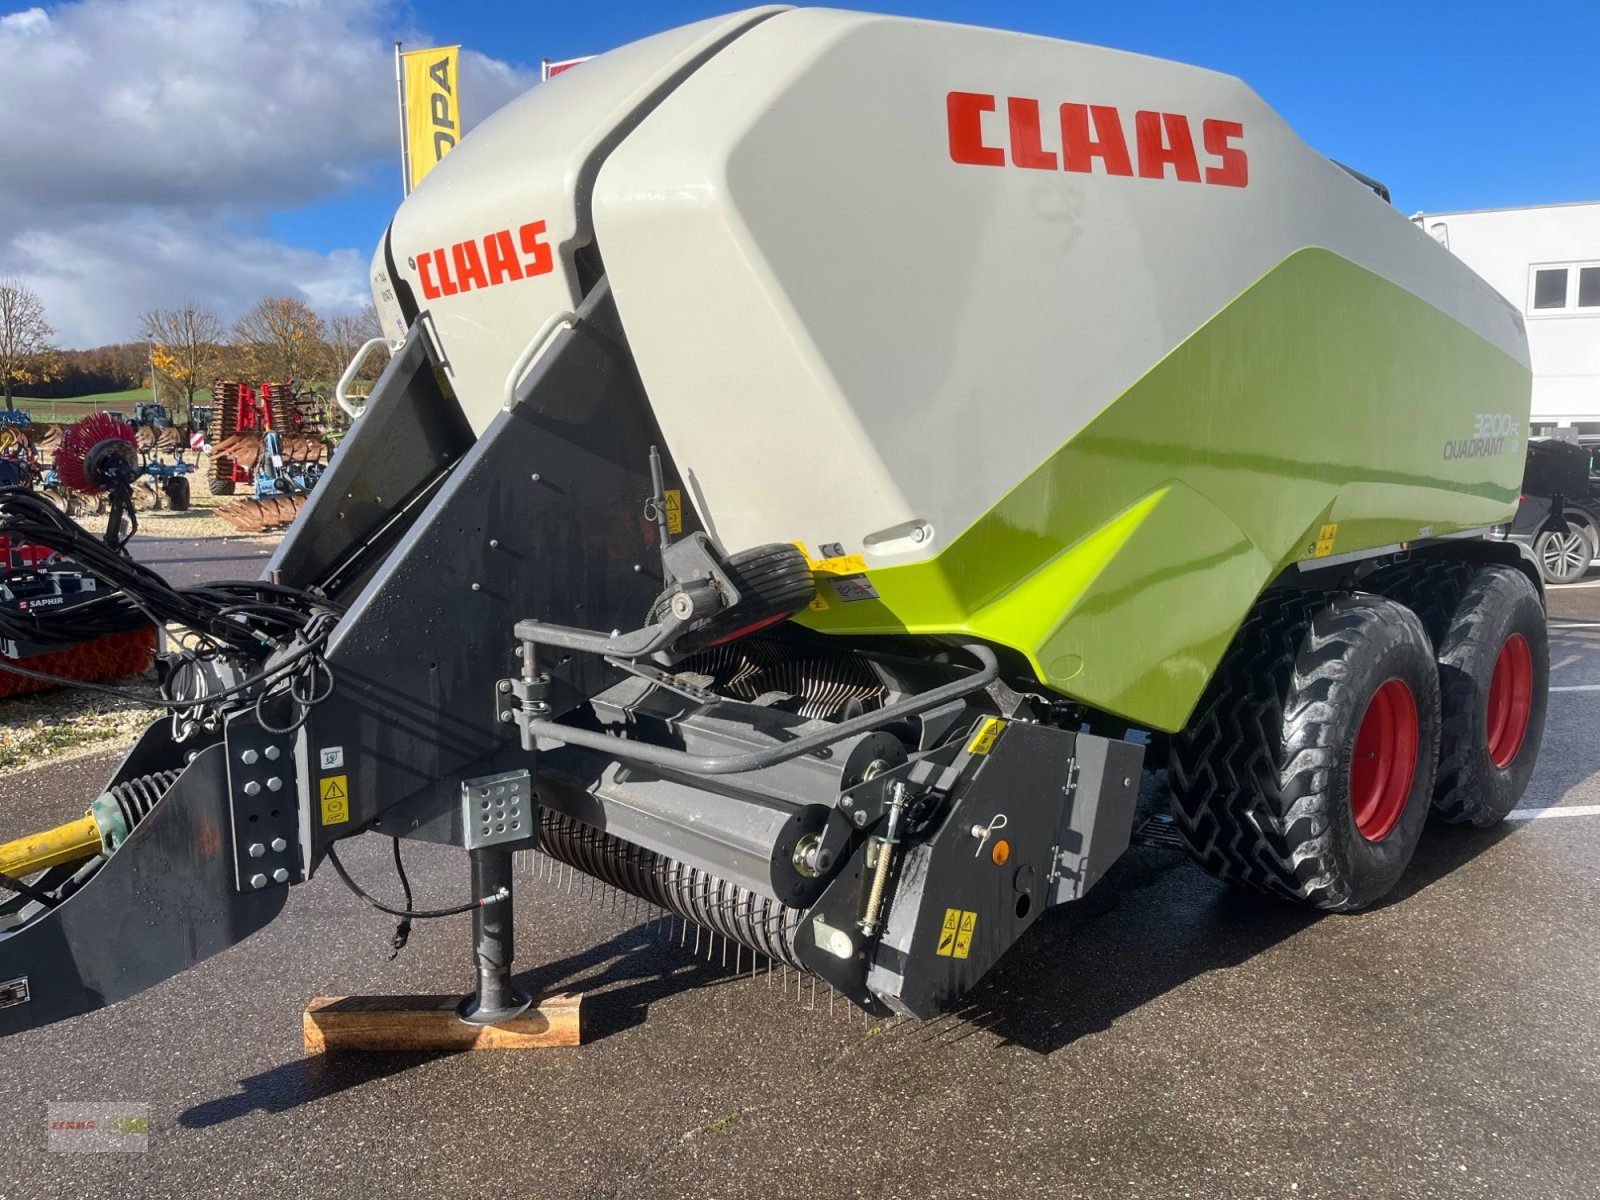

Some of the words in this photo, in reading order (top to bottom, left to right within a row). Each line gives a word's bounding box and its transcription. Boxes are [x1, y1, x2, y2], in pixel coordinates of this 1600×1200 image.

[946, 91, 1248, 188] CLAAS
[416, 219, 554, 300] CLAAS
[1472, 413, 1511, 439] 3200
[1443, 437, 1505, 461] QUADRANT
[30, 597, 64, 608] SAPHIR
